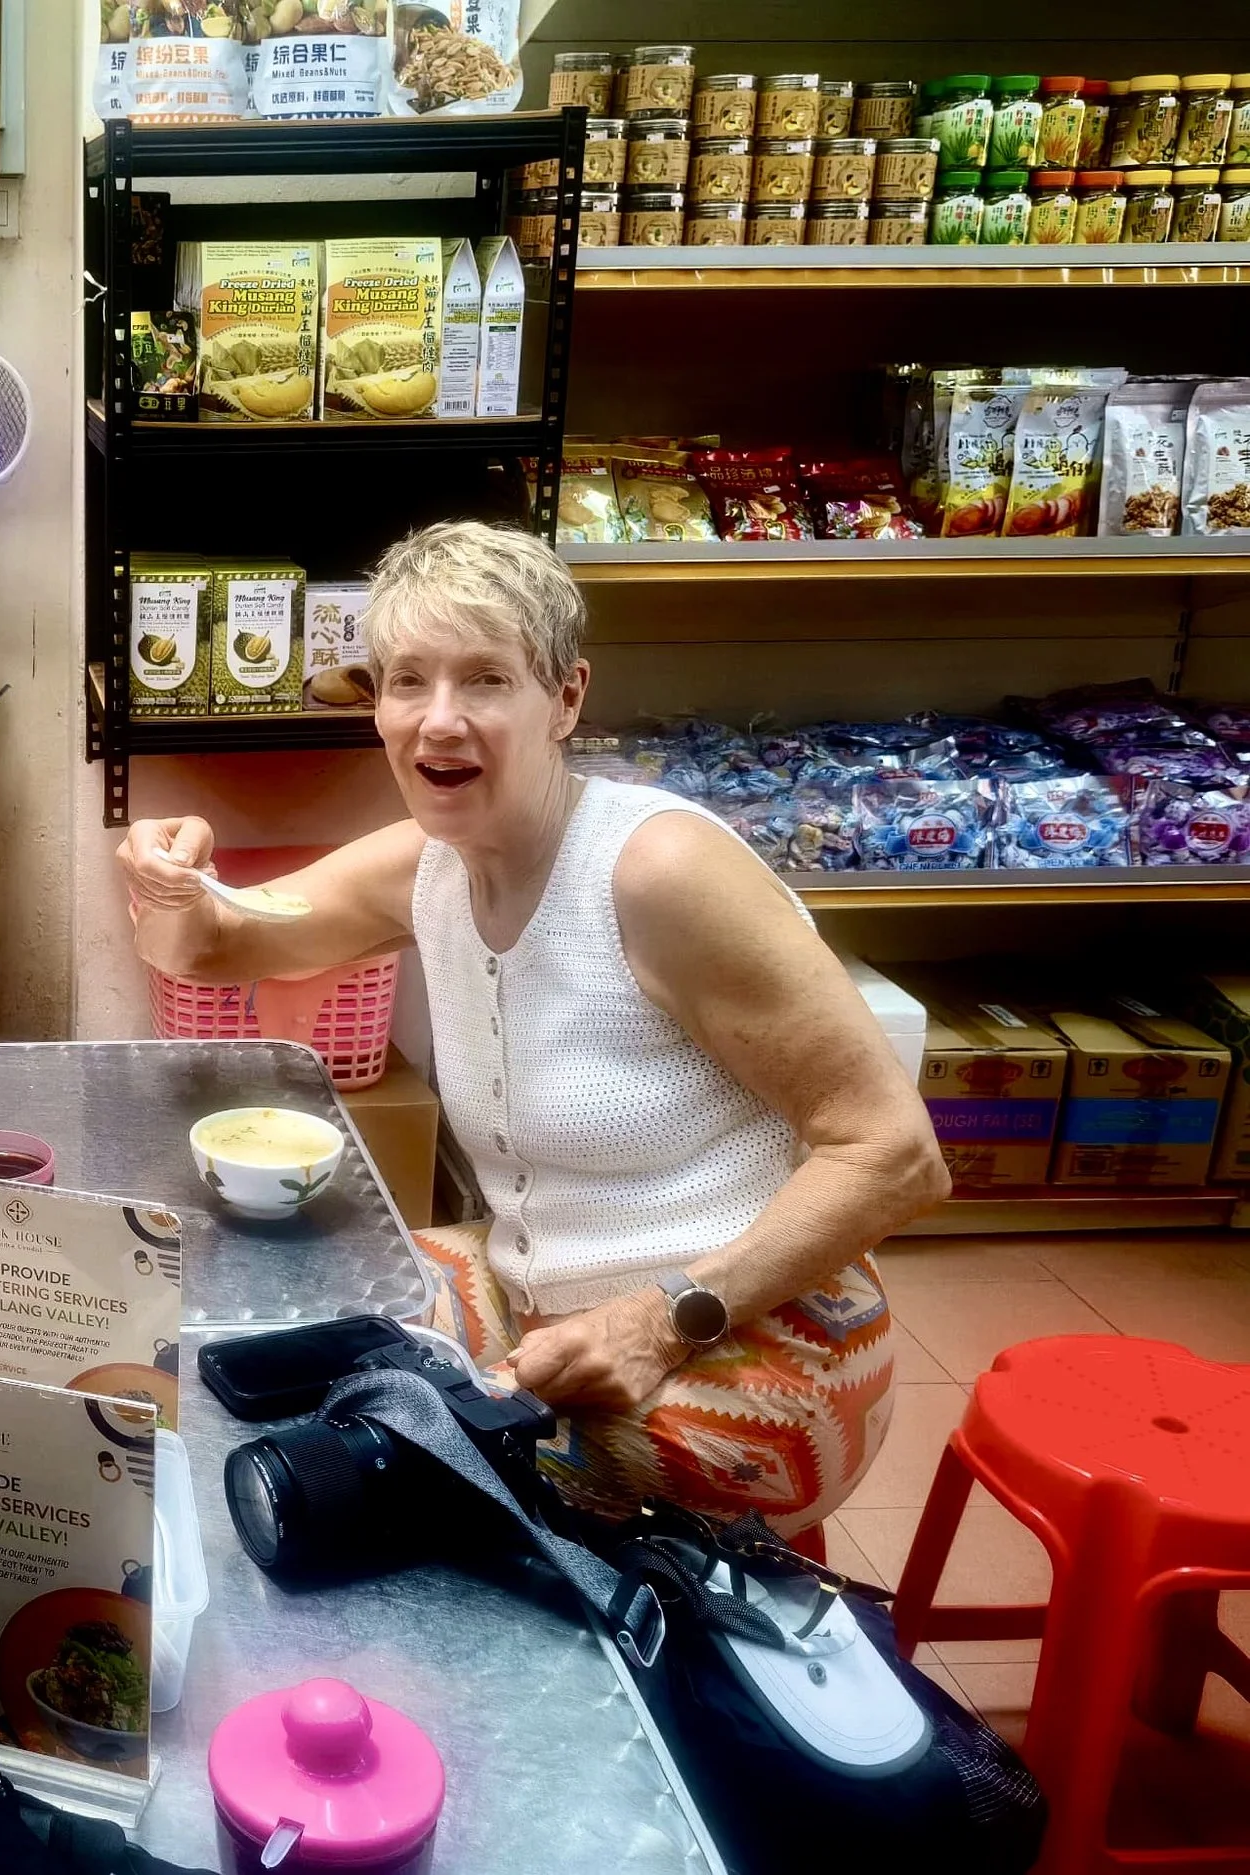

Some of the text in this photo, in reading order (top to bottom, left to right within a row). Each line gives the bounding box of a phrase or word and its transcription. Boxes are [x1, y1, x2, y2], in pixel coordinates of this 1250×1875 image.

[136, 44, 209, 65] 缤纷豆果
[273, 43, 346, 65] 综合果仁
[272, 67, 347, 79] Mixed Beans&Nuts
[220, 279, 296, 289] Freeze Dried
[343, 275, 419, 288] Freeze Dried
[233, 289, 294, 304] Musang
[356, 287, 418, 302] Musang
[208, 300, 296, 316] King Durian
[332, 299, 418, 315] King Durian
[139, 597, 191, 605] Musang King
[234, 594, 285, 603] Musang King
[311, 604, 341, 667] 流心酥
[931, 1115, 978, 1129] OUGH
[16, 1231, 62, 1248] HOUSE
[1, 1263, 71, 1286] PROVIDE
[54, 1290, 128, 1314] SERVICES
[46, 1306, 110, 1330] VALLEY!
[1, 1497, 91, 1528] SERVICES
[8, 1548, 25, 1559] OUR
[26, 1553, 69, 1569] AUTHENTIC
[44, 1566, 55, 1577] TO
